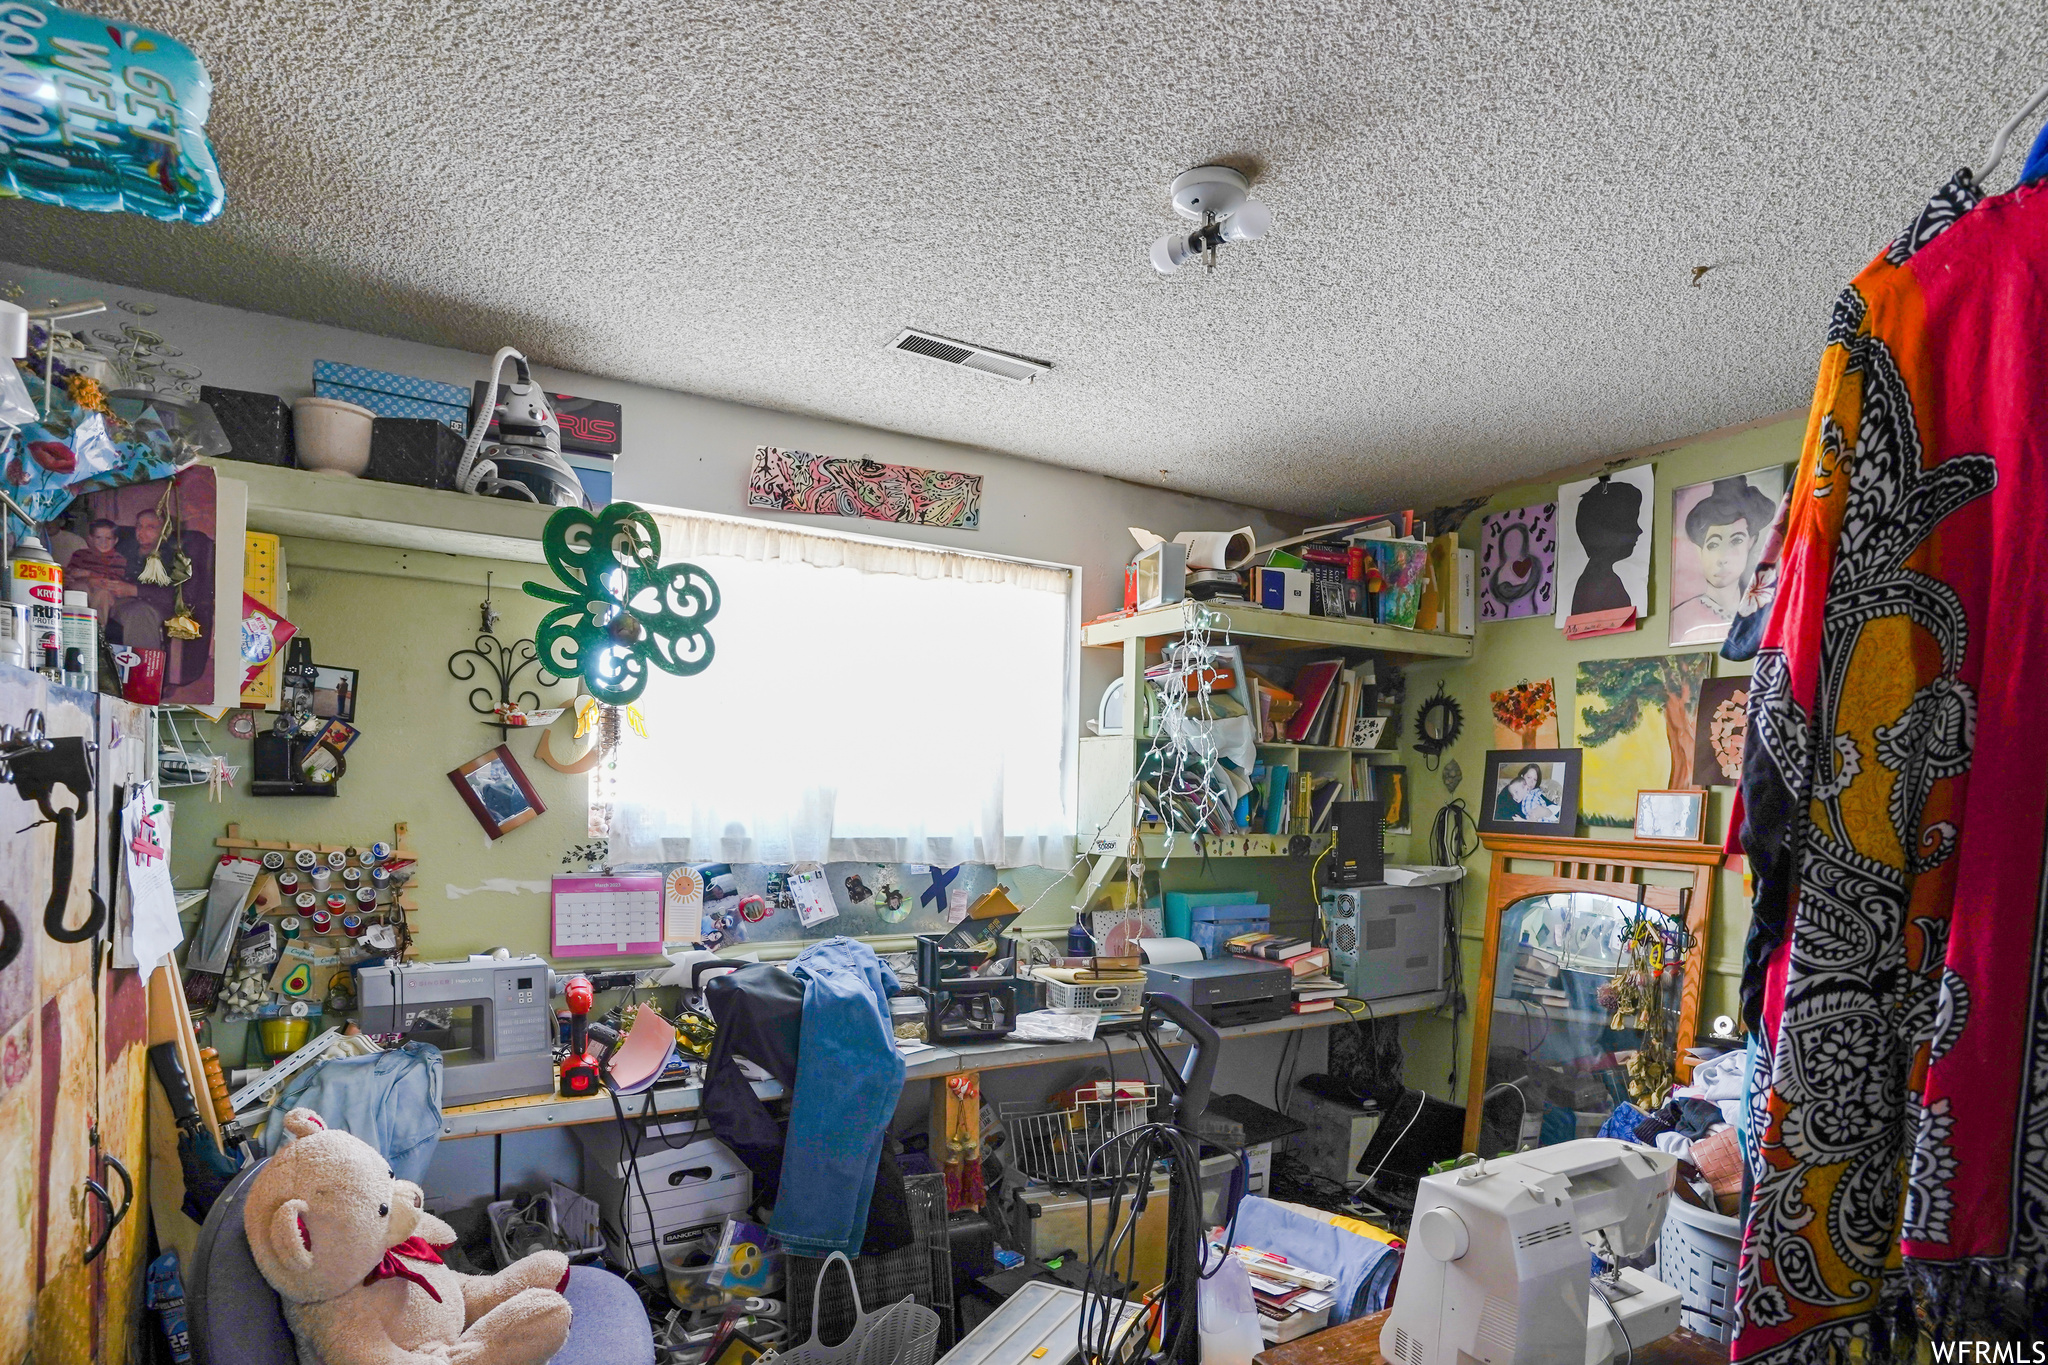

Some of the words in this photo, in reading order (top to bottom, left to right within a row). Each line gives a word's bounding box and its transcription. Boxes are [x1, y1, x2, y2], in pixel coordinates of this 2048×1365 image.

[49, 36, 121, 146] WELL
[123, 66, 183, 155] GET
[20, 564, 46, 578] 25%
[33, 605, 62, 620] RUS
[419, 979, 450, 987] SINGER
[666, 1230, 702, 1242] BANKERS
